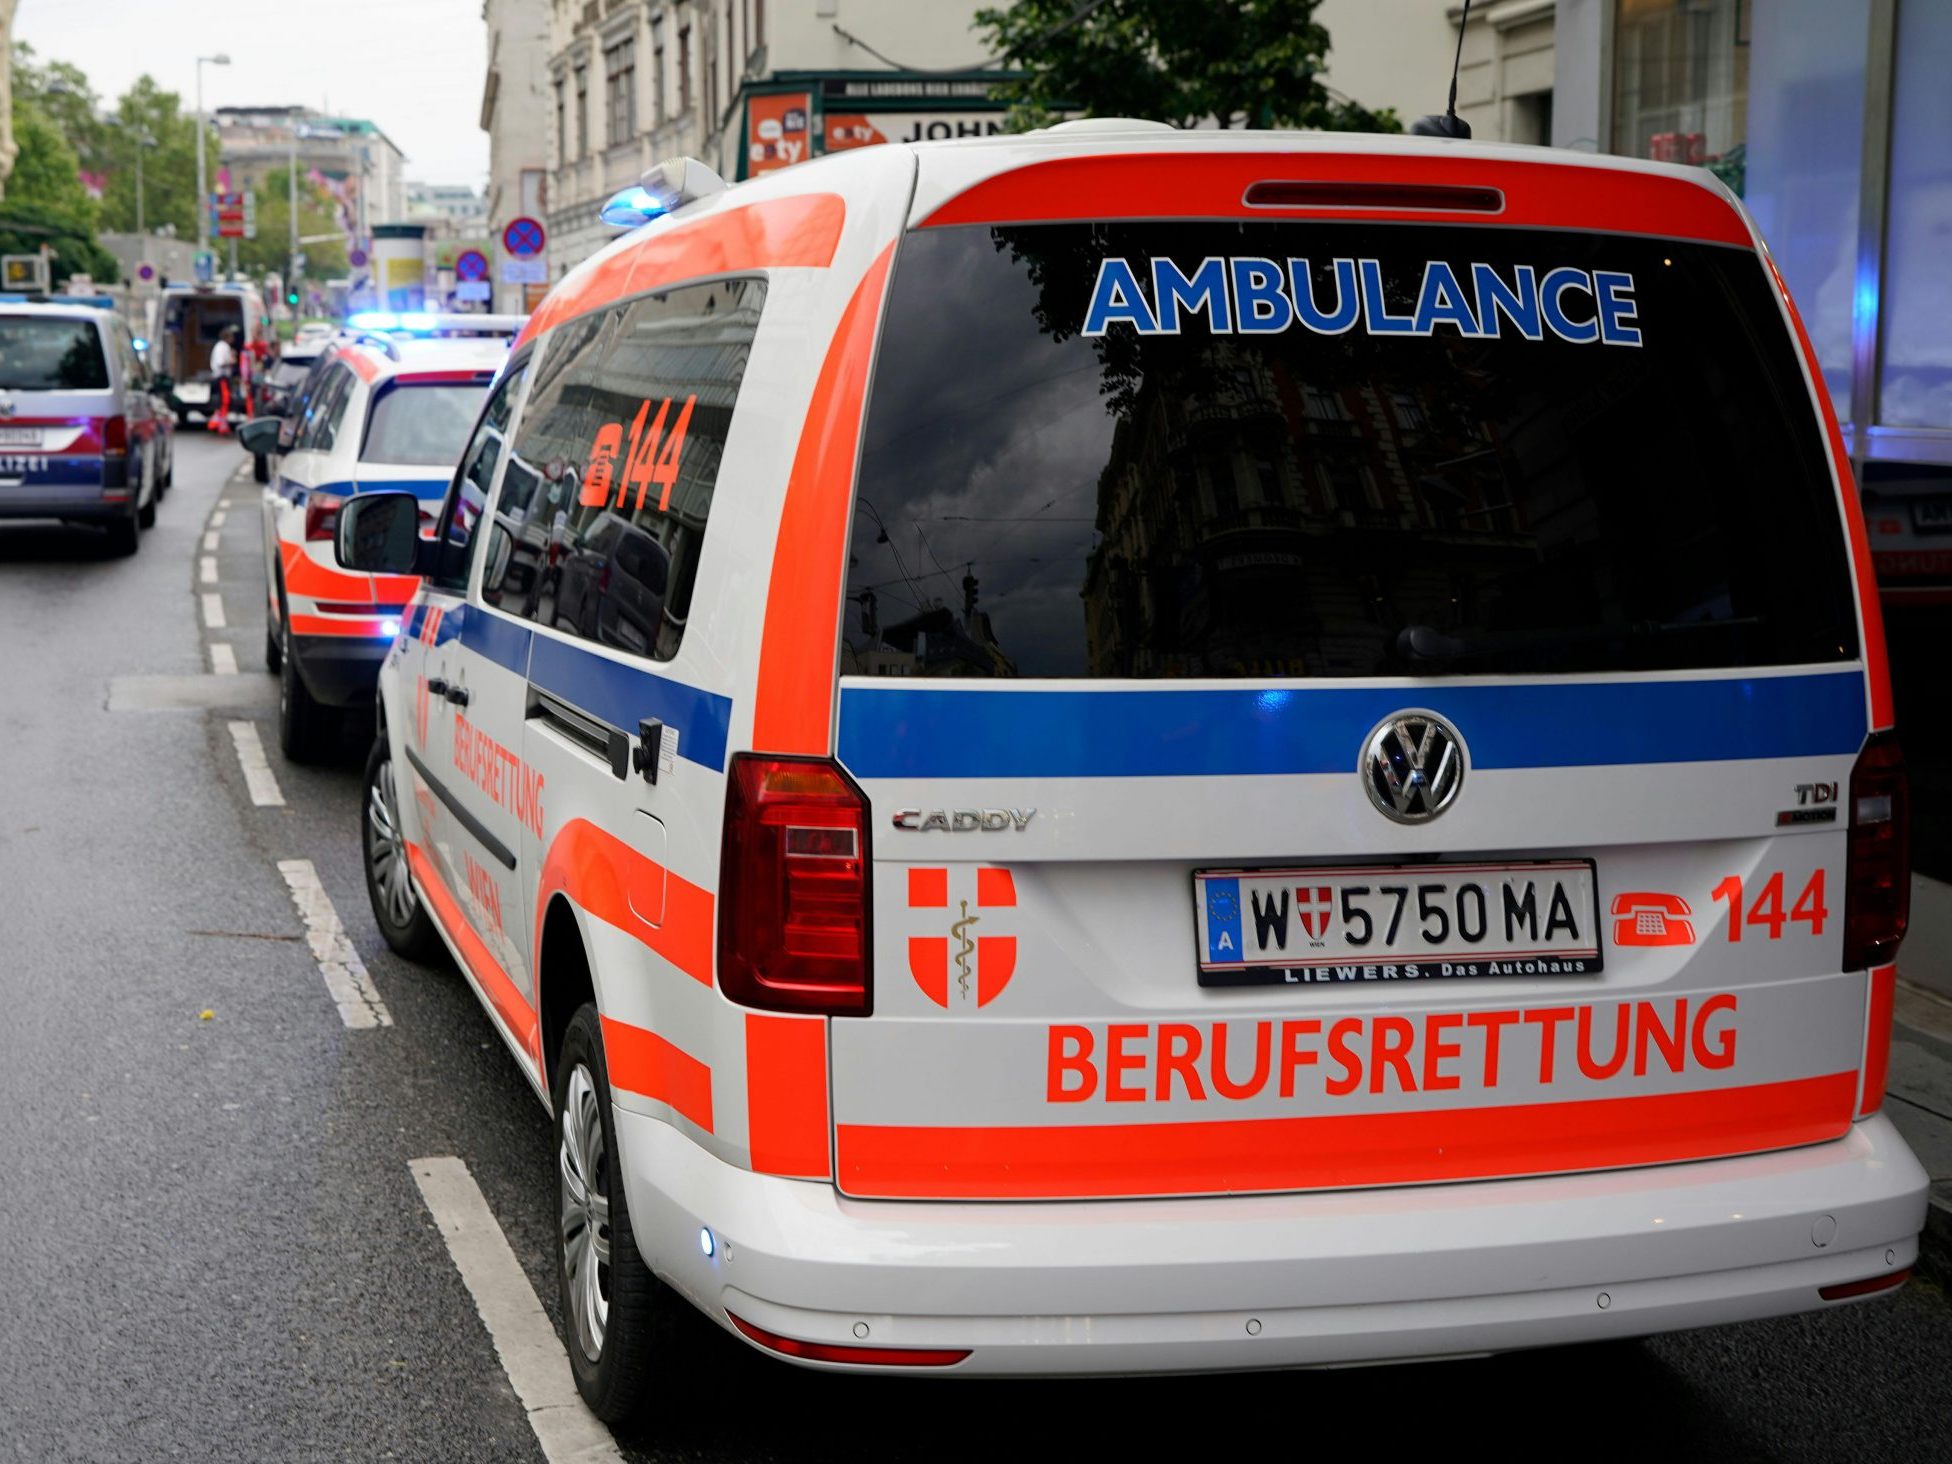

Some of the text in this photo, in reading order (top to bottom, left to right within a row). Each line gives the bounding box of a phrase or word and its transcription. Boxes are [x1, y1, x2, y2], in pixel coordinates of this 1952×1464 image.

[1081, 257, 1643, 347] AMBULANCE
[616, 393, 698, 512] 144
[453, 711, 545, 842] BERUFSRETTUNG
[1794, 782, 1838, 805] TDI
[892, 807, 1038, 832] CADDY
[1217, 931, 1234, 951] A
[1251, 881, 1580, 951] W 5750 MA
[1711, 868, 1828, 943] 144
[1284, 958, 1585, 983] LIEWERS. Das Autohaus
[1045, 993, 1739, 1103] BERUFSRETTUNG
